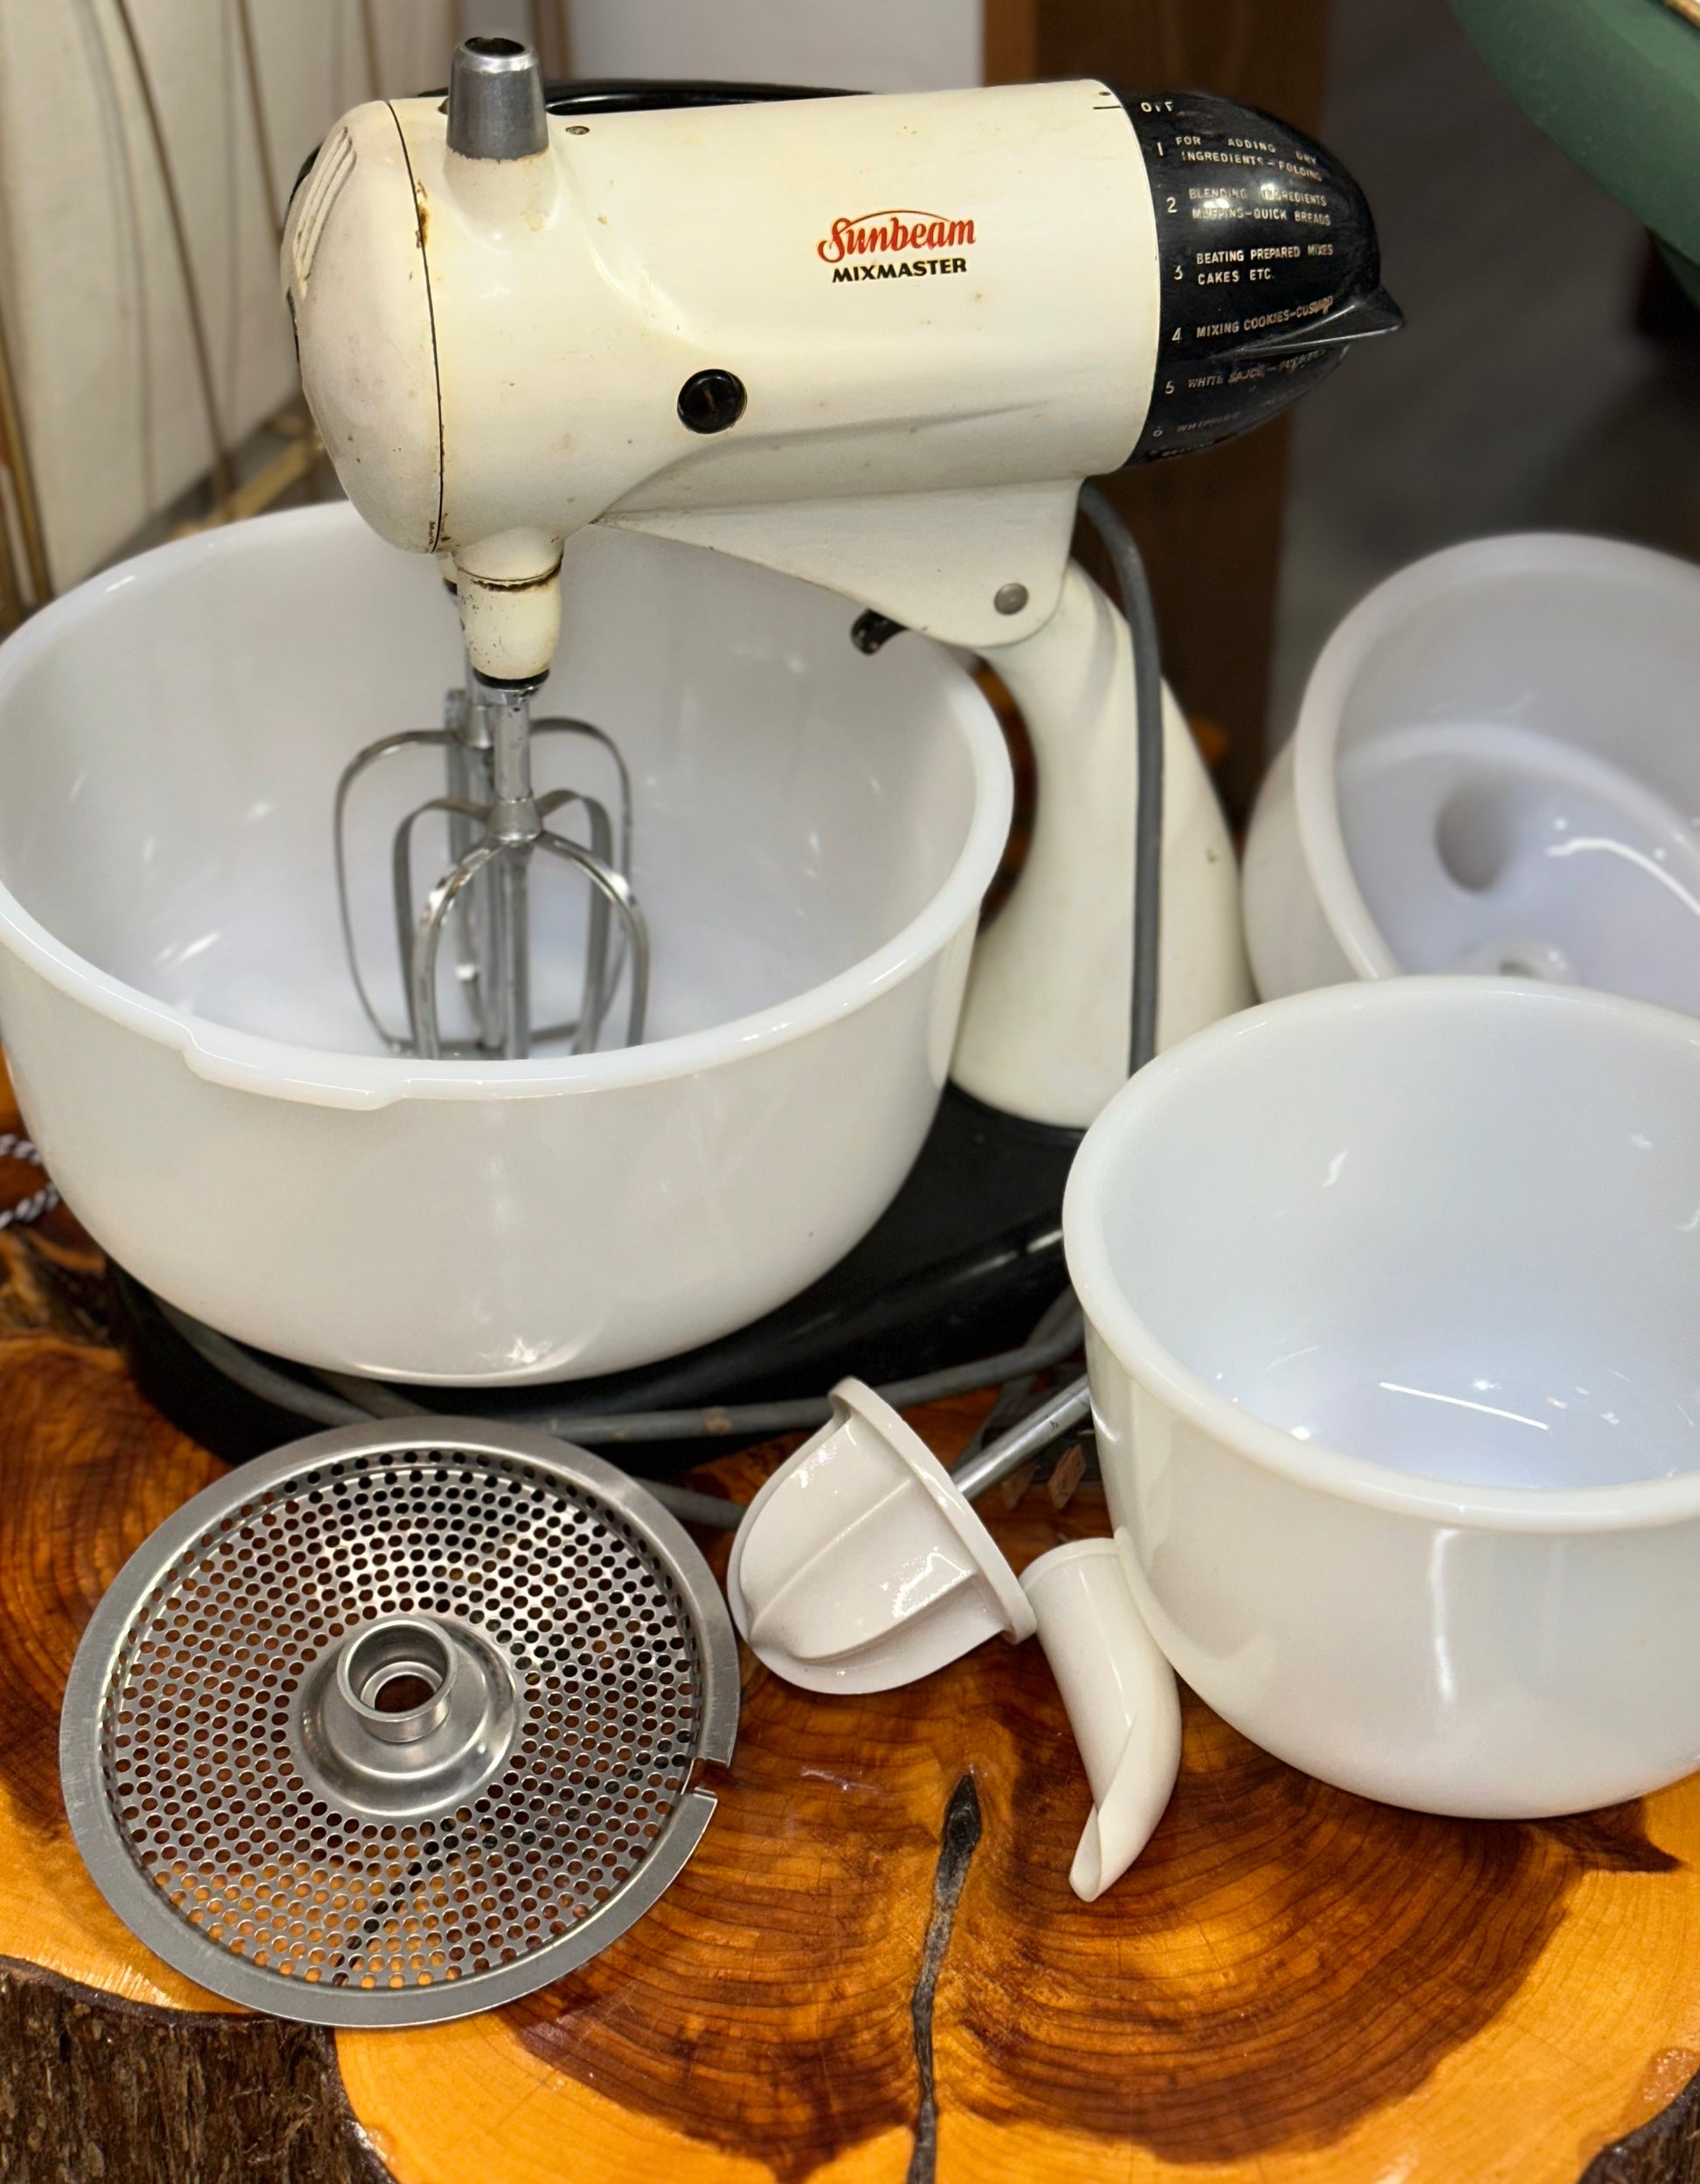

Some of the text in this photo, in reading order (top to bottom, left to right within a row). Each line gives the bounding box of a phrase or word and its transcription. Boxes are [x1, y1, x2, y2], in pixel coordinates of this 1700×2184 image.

[1175, 136, 1202, 147] FOR
[1227, 137, 1276, 154] ADDING
[1188, 188, 1247, 200] BLENDING
[1166, 197, 1178, 214] 2
[1294, 212, 1331, 226] BREADS
[818, 214, 977, 264] Sunbeam
[1196, 243, 1334, 265] BEATING PREPARED MIXES
[832, 257, 967, 283] MIXMASTER
[1198, 269, 1240, 286] CAKES
[1171, 327, 1183, 342] 4
[1196, 321, 1240, 338] MIXING
[1164, 380, 1175, 394] 5
